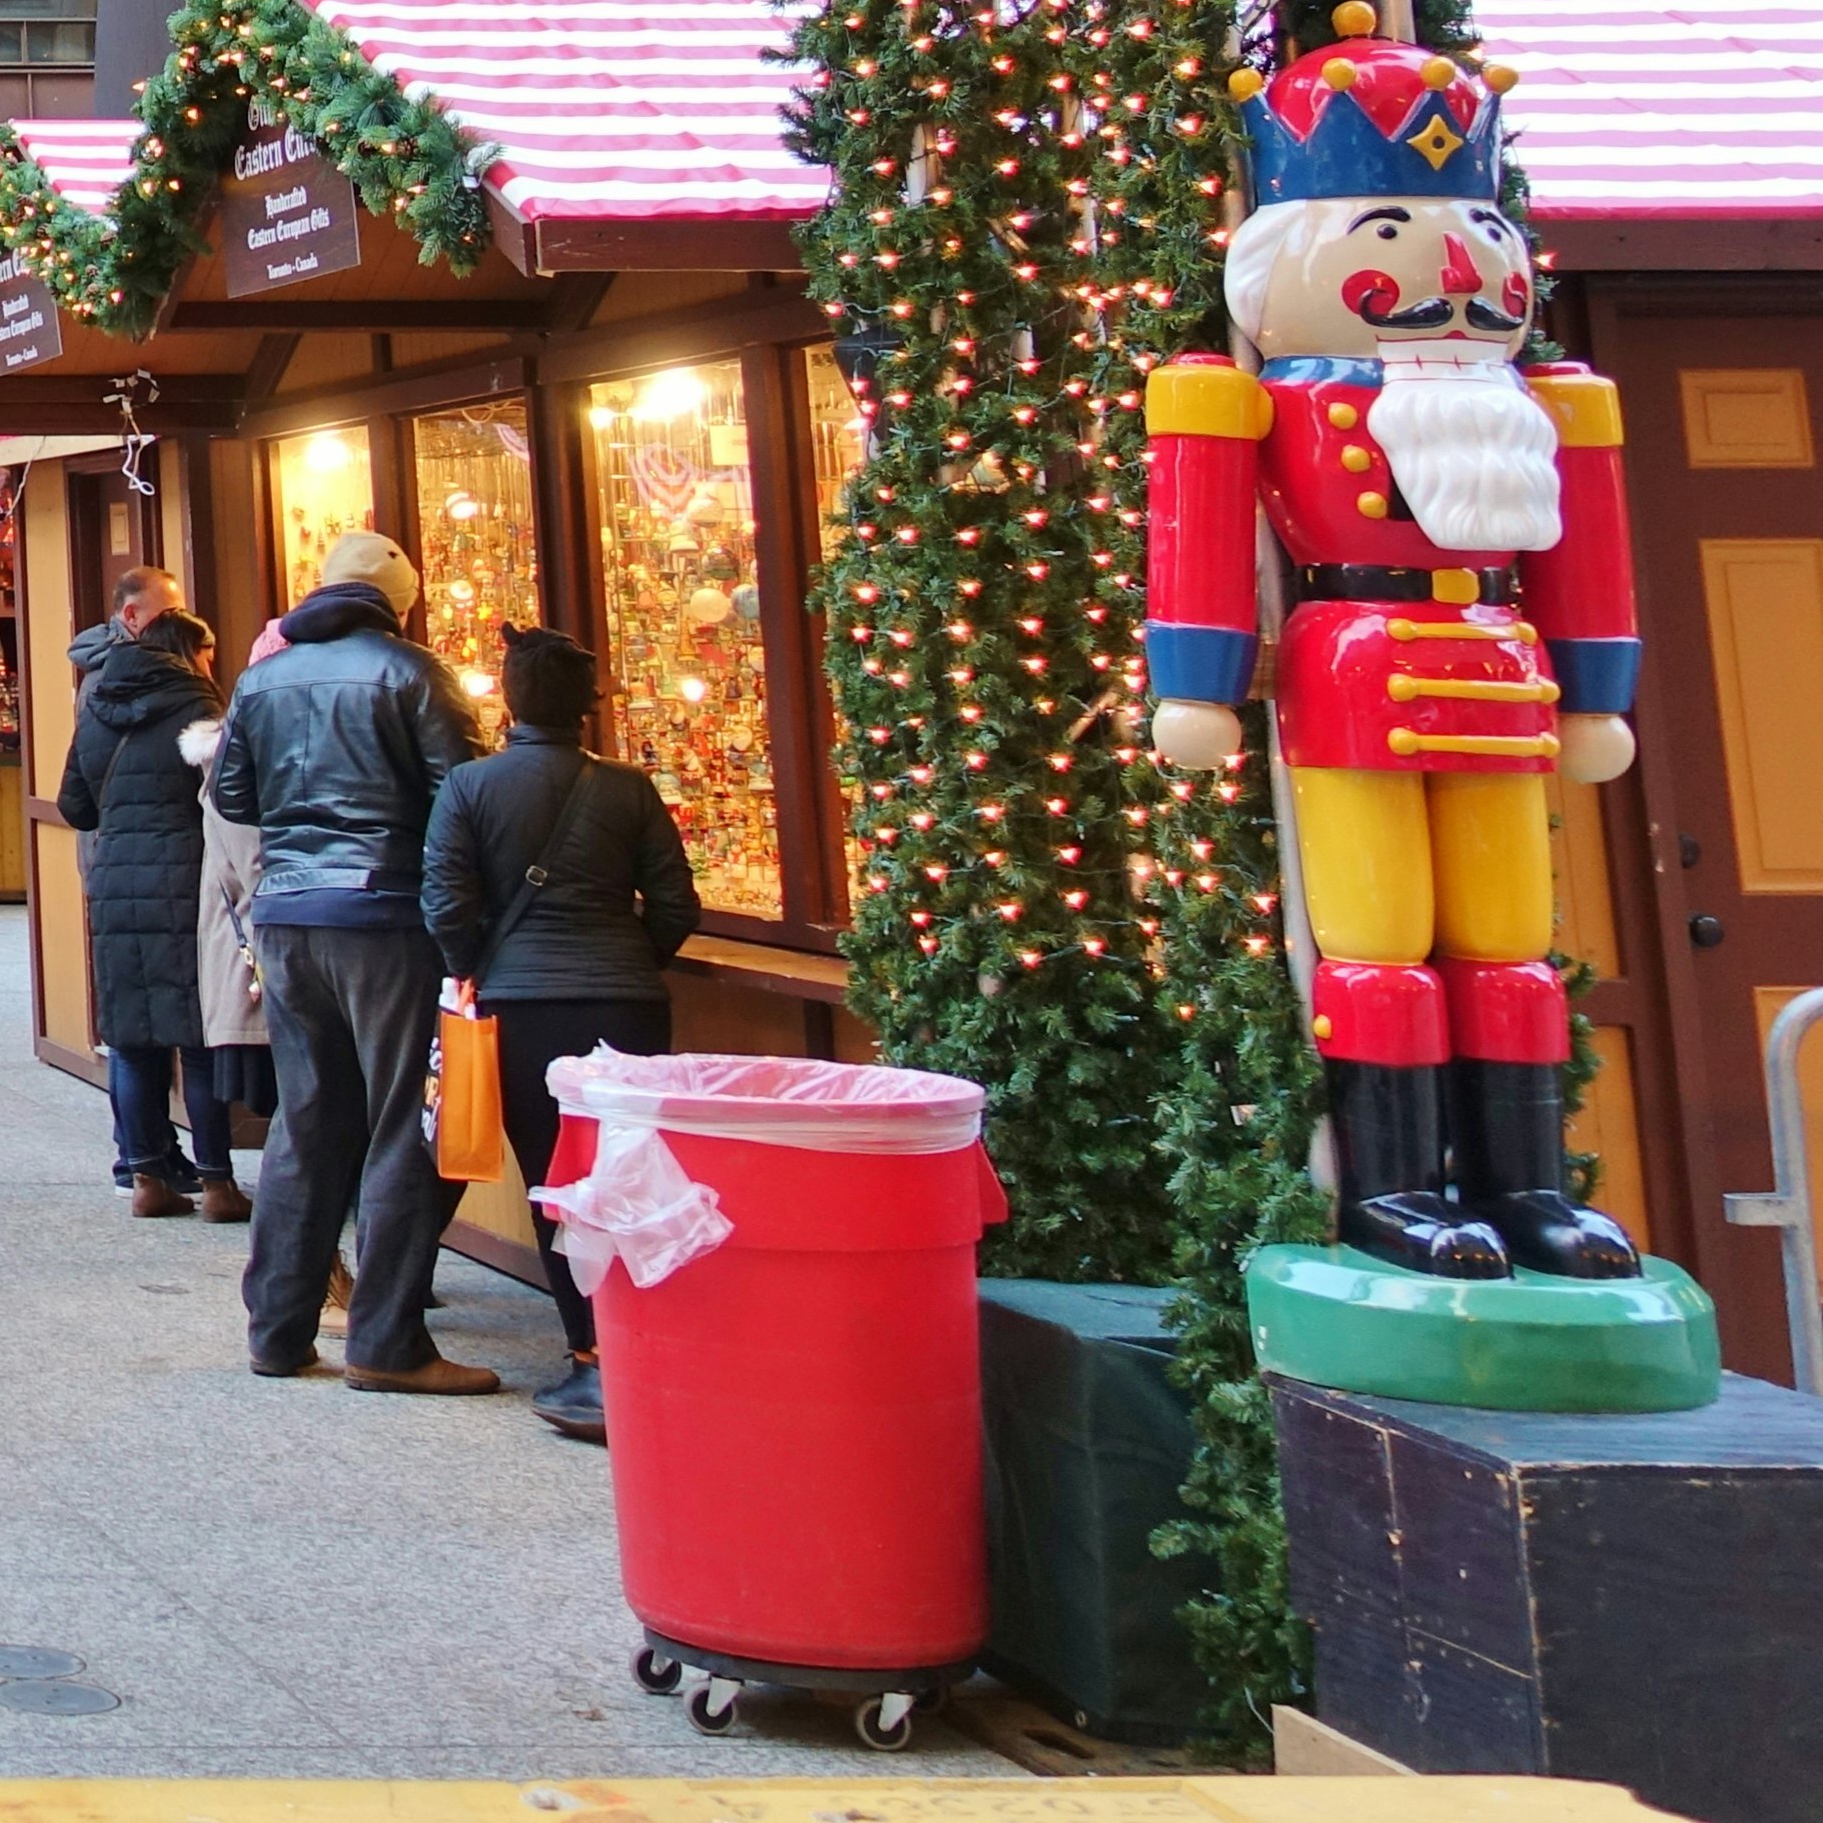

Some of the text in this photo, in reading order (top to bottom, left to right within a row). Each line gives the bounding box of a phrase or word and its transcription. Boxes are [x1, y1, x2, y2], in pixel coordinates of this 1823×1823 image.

[235, 140, 282, 181] Eastern
[265, 185, 307, 219] Handcrafted
[248, 208, 330, 250] Eastern European Gifts
[296, 253, 318, 273] Canada
